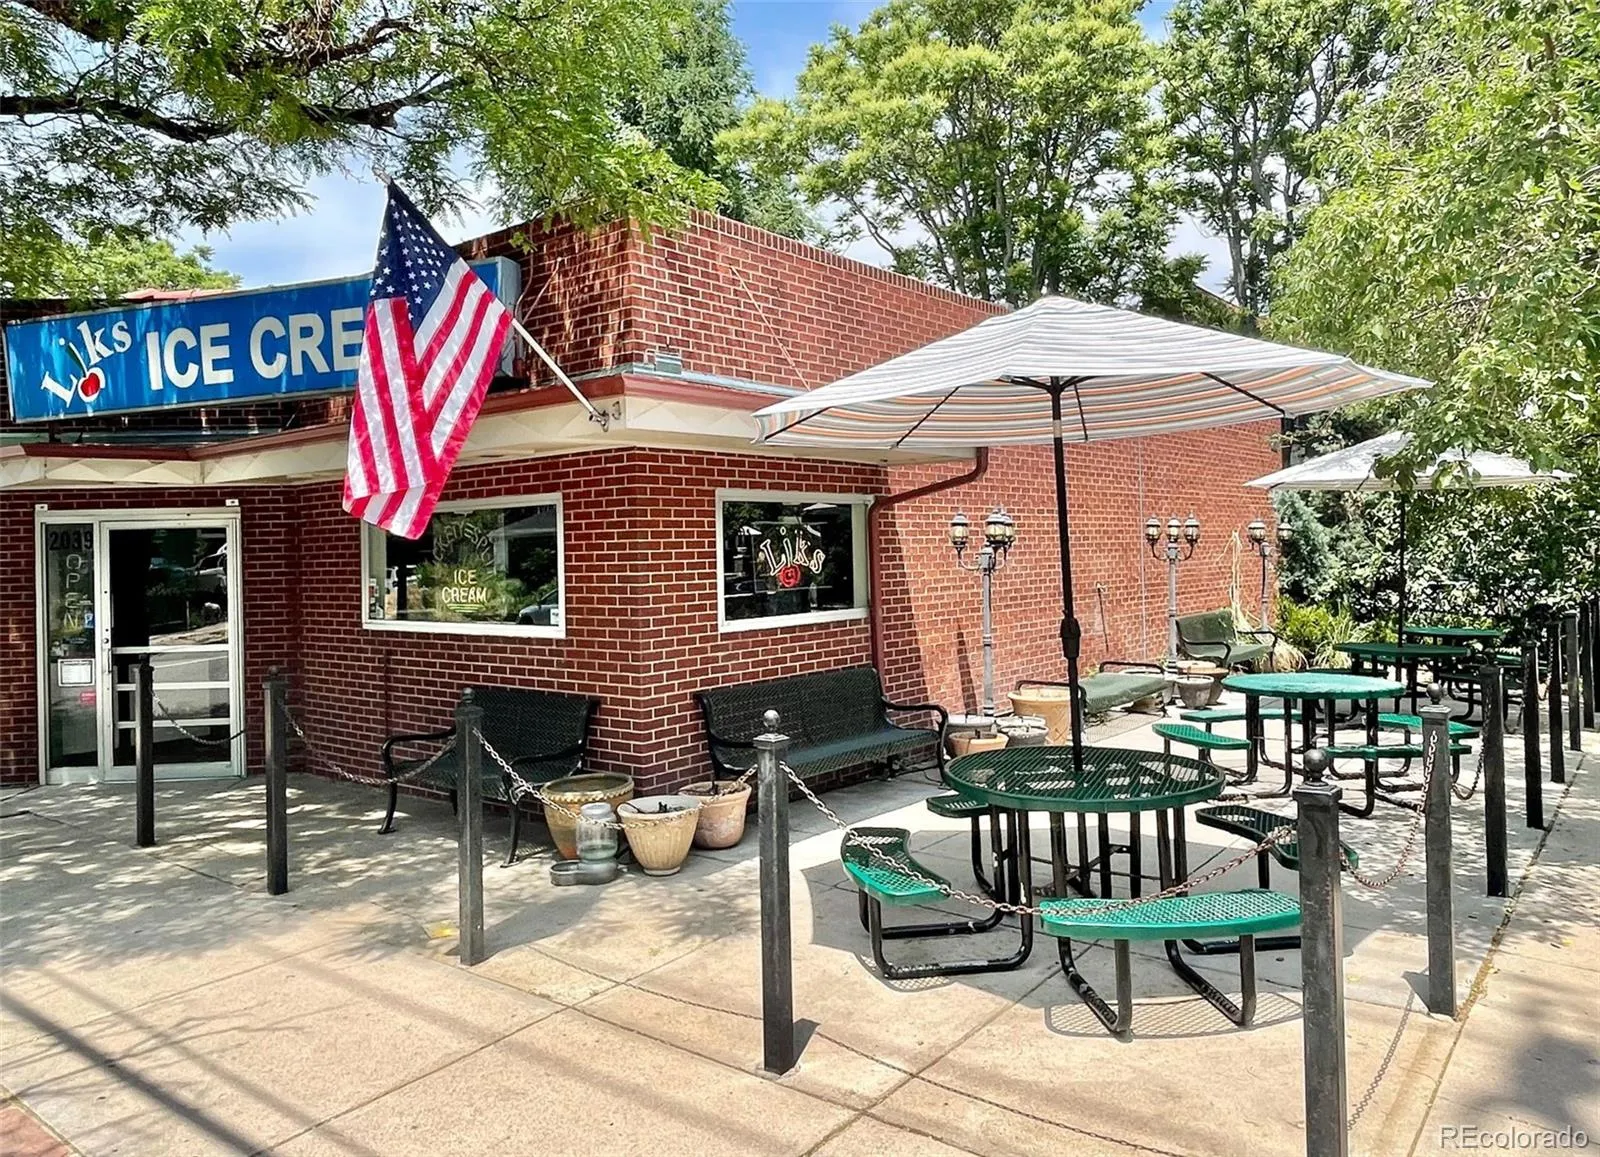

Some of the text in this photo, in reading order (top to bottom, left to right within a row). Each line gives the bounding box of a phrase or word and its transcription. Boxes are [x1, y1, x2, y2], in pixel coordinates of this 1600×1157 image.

[41, 319, 133, 407] Liks
[145, 306, 364, 391] ICE CRE
[49, 530, 93, 550] 2039
[760, 526, 826, 577] Liks
[64, 553, 82, 629] OPEN
[441, 586, 488, 604] CREAM
[453, 568, 477, 586] ICE
